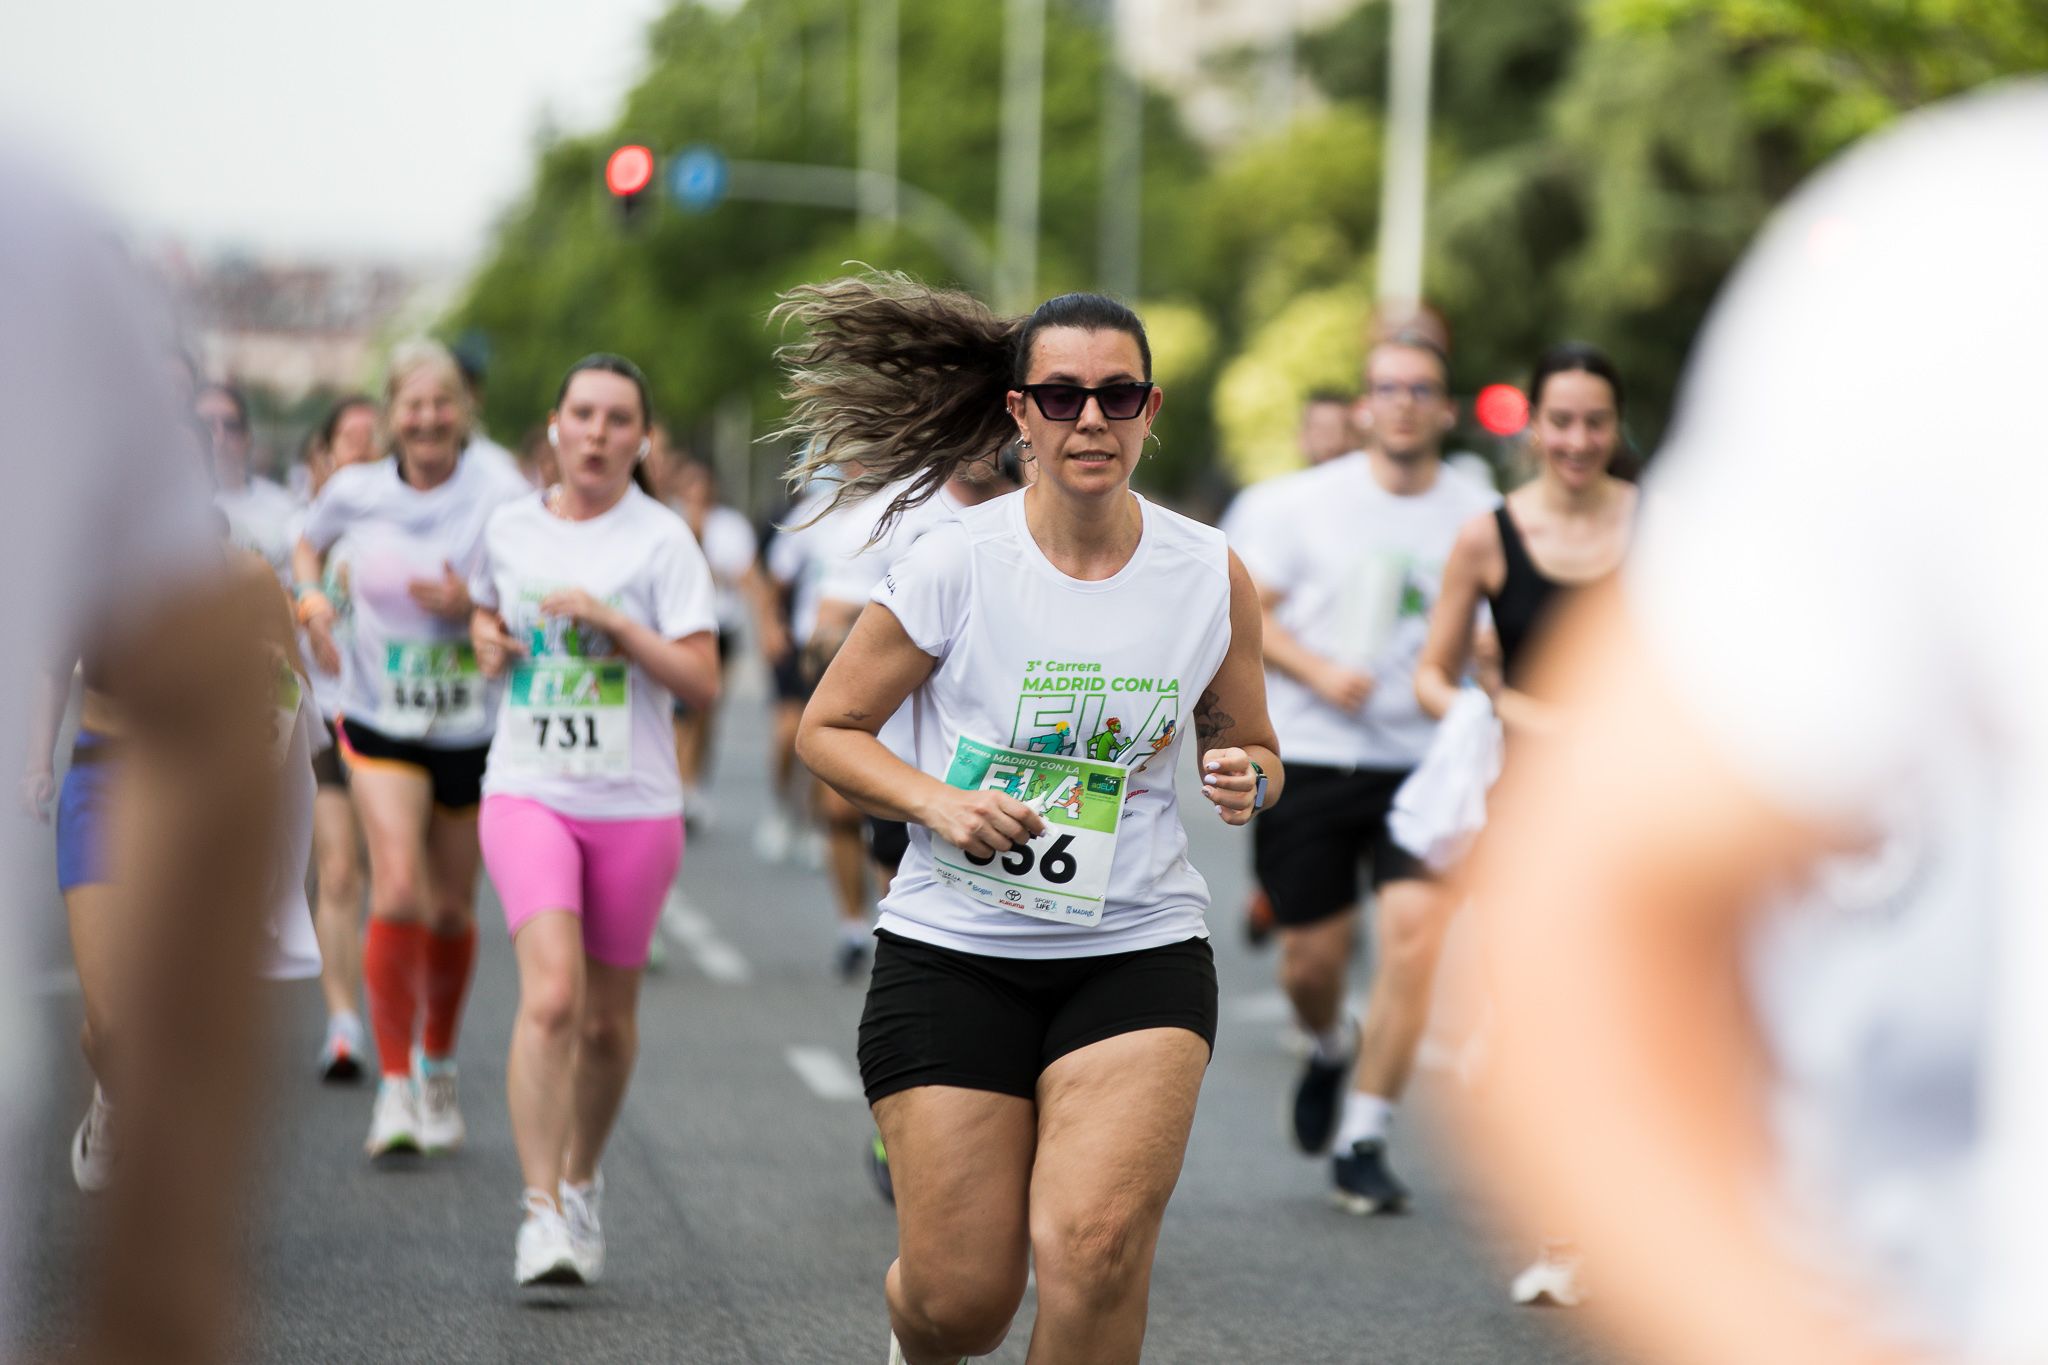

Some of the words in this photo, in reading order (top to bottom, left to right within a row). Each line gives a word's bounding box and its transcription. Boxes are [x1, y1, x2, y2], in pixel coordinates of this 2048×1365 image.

[1046, 660, 1102, 672] Carrera
[1023, 676, 1105, 692] MADRID
[1111, 678, 1153, 693] CON
[1156, 678, 1180, 693] LA
[533, 714, 599, 749] 731
[1010, 693, 1179, 766] ELA
[993, 753, 1039, 768] MADRID
[1040, 760, 1066, 772] CON
[1066, 765, 1080, 775] LA
